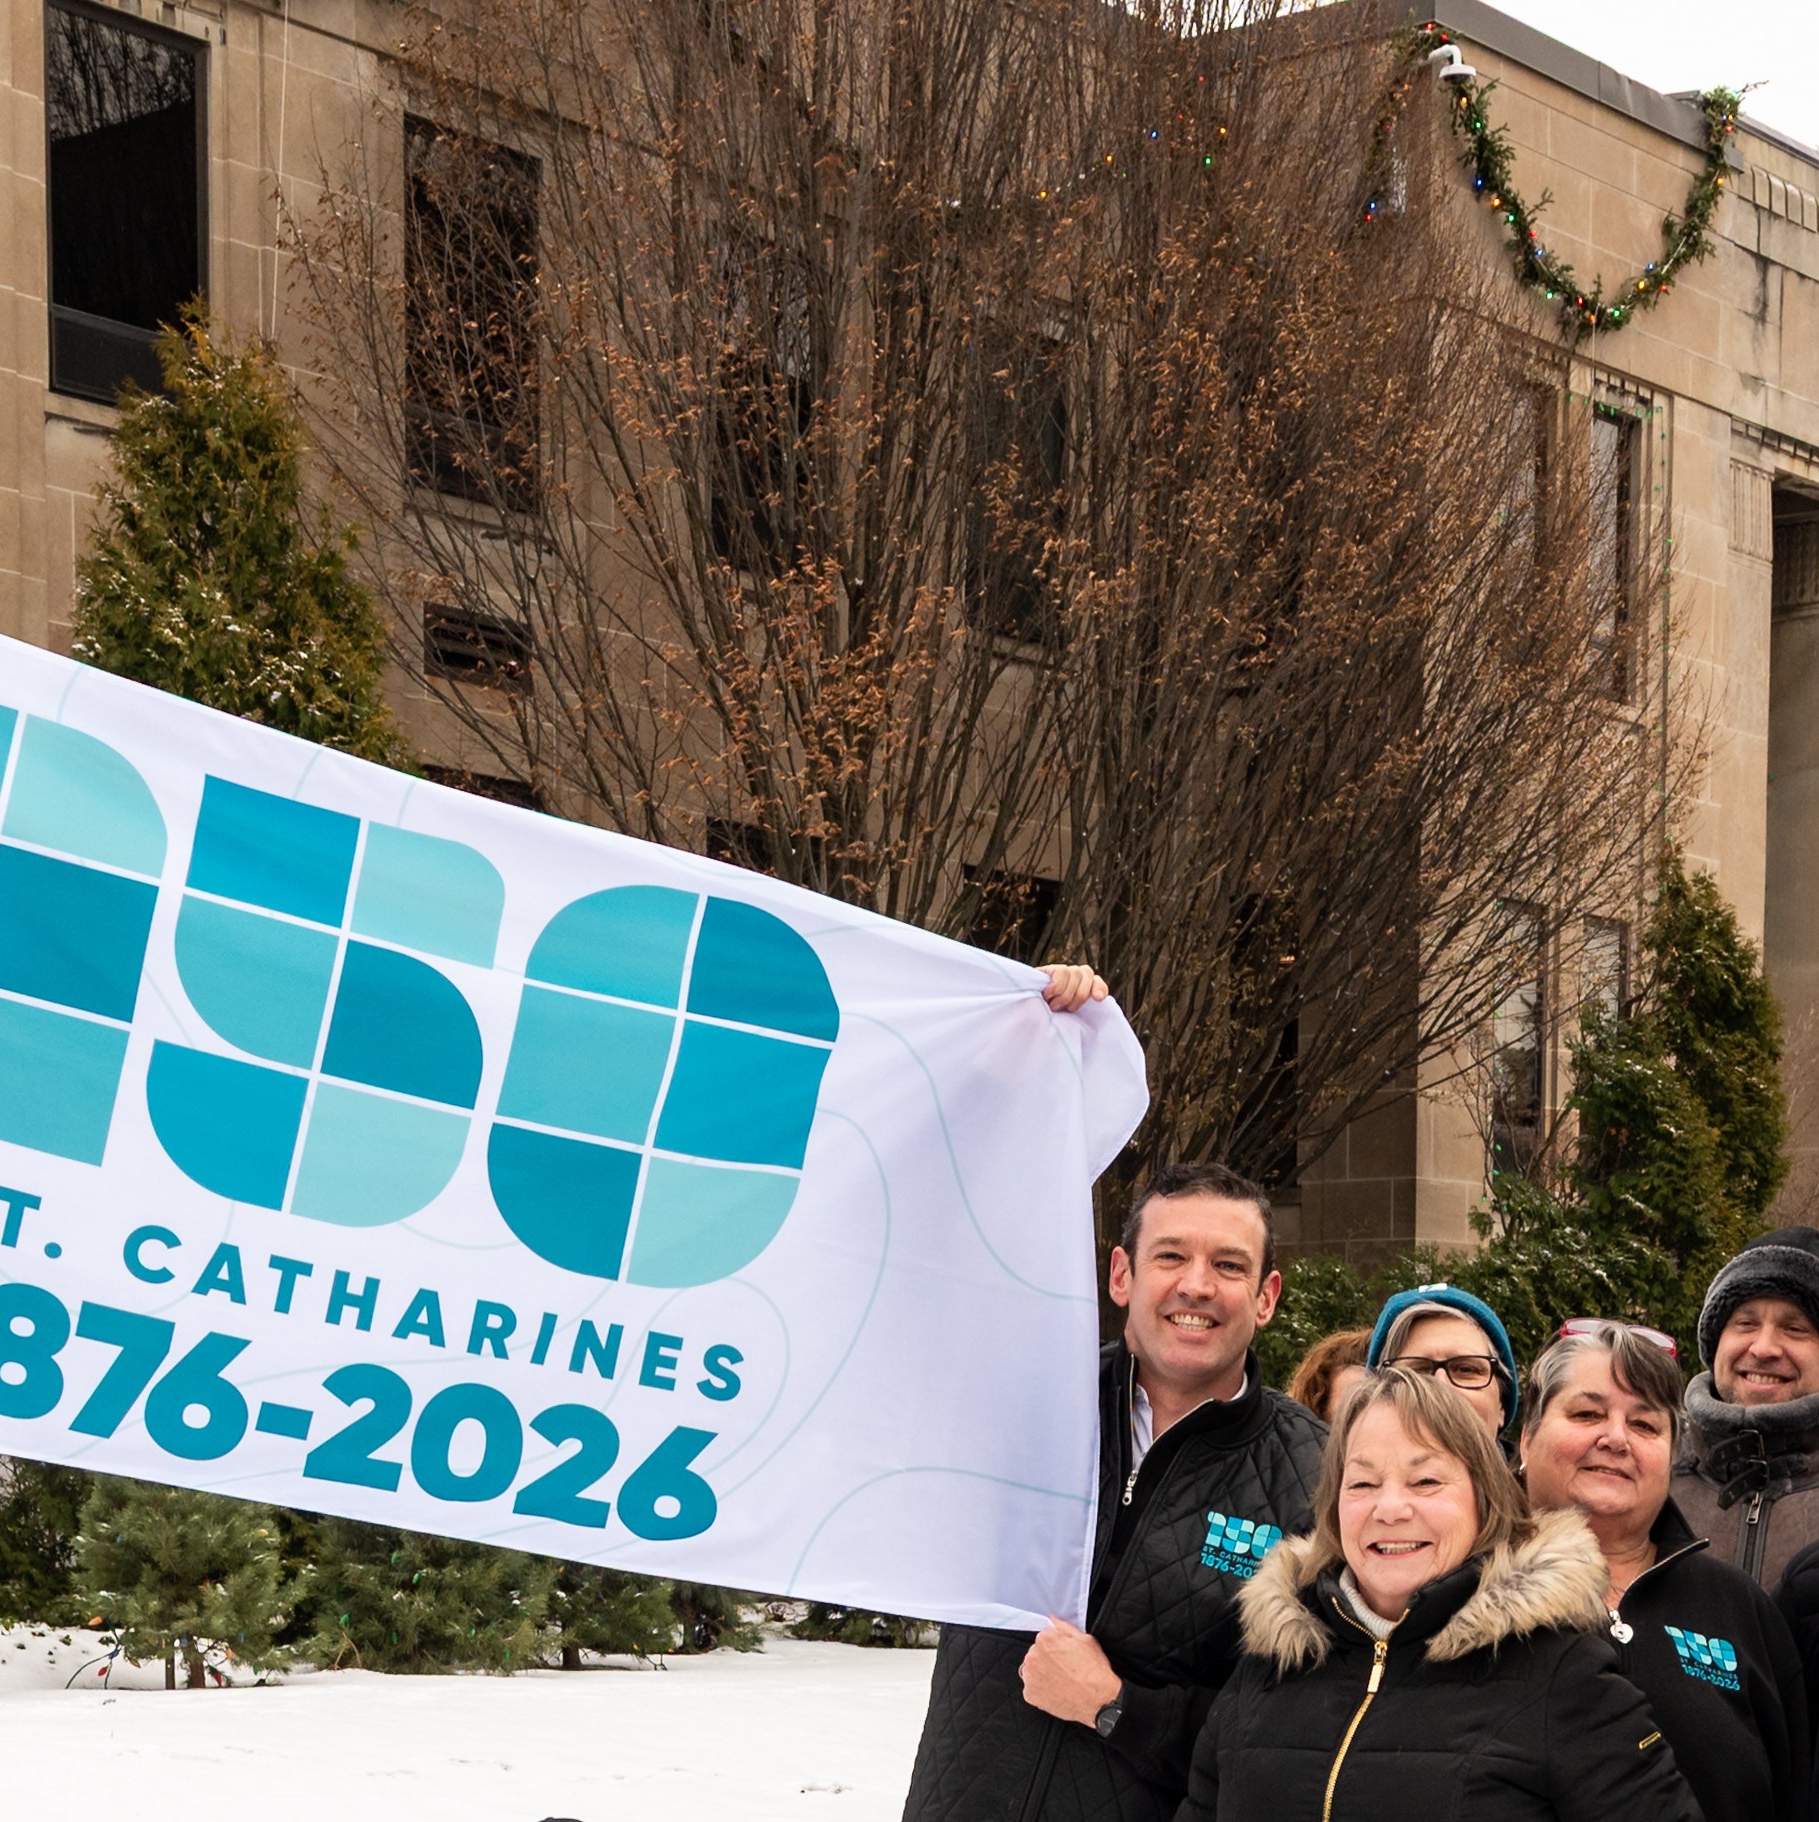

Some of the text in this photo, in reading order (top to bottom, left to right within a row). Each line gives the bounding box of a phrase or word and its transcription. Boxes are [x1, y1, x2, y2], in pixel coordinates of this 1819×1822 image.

[123, 1225, 744, 1402] CATHARINES
[1201, 1553, 1258, 1579] 1876-20
[1664, 1625, 1738, 1671] 150
[1682, 1664, 1740, 1691] 1876-2026
